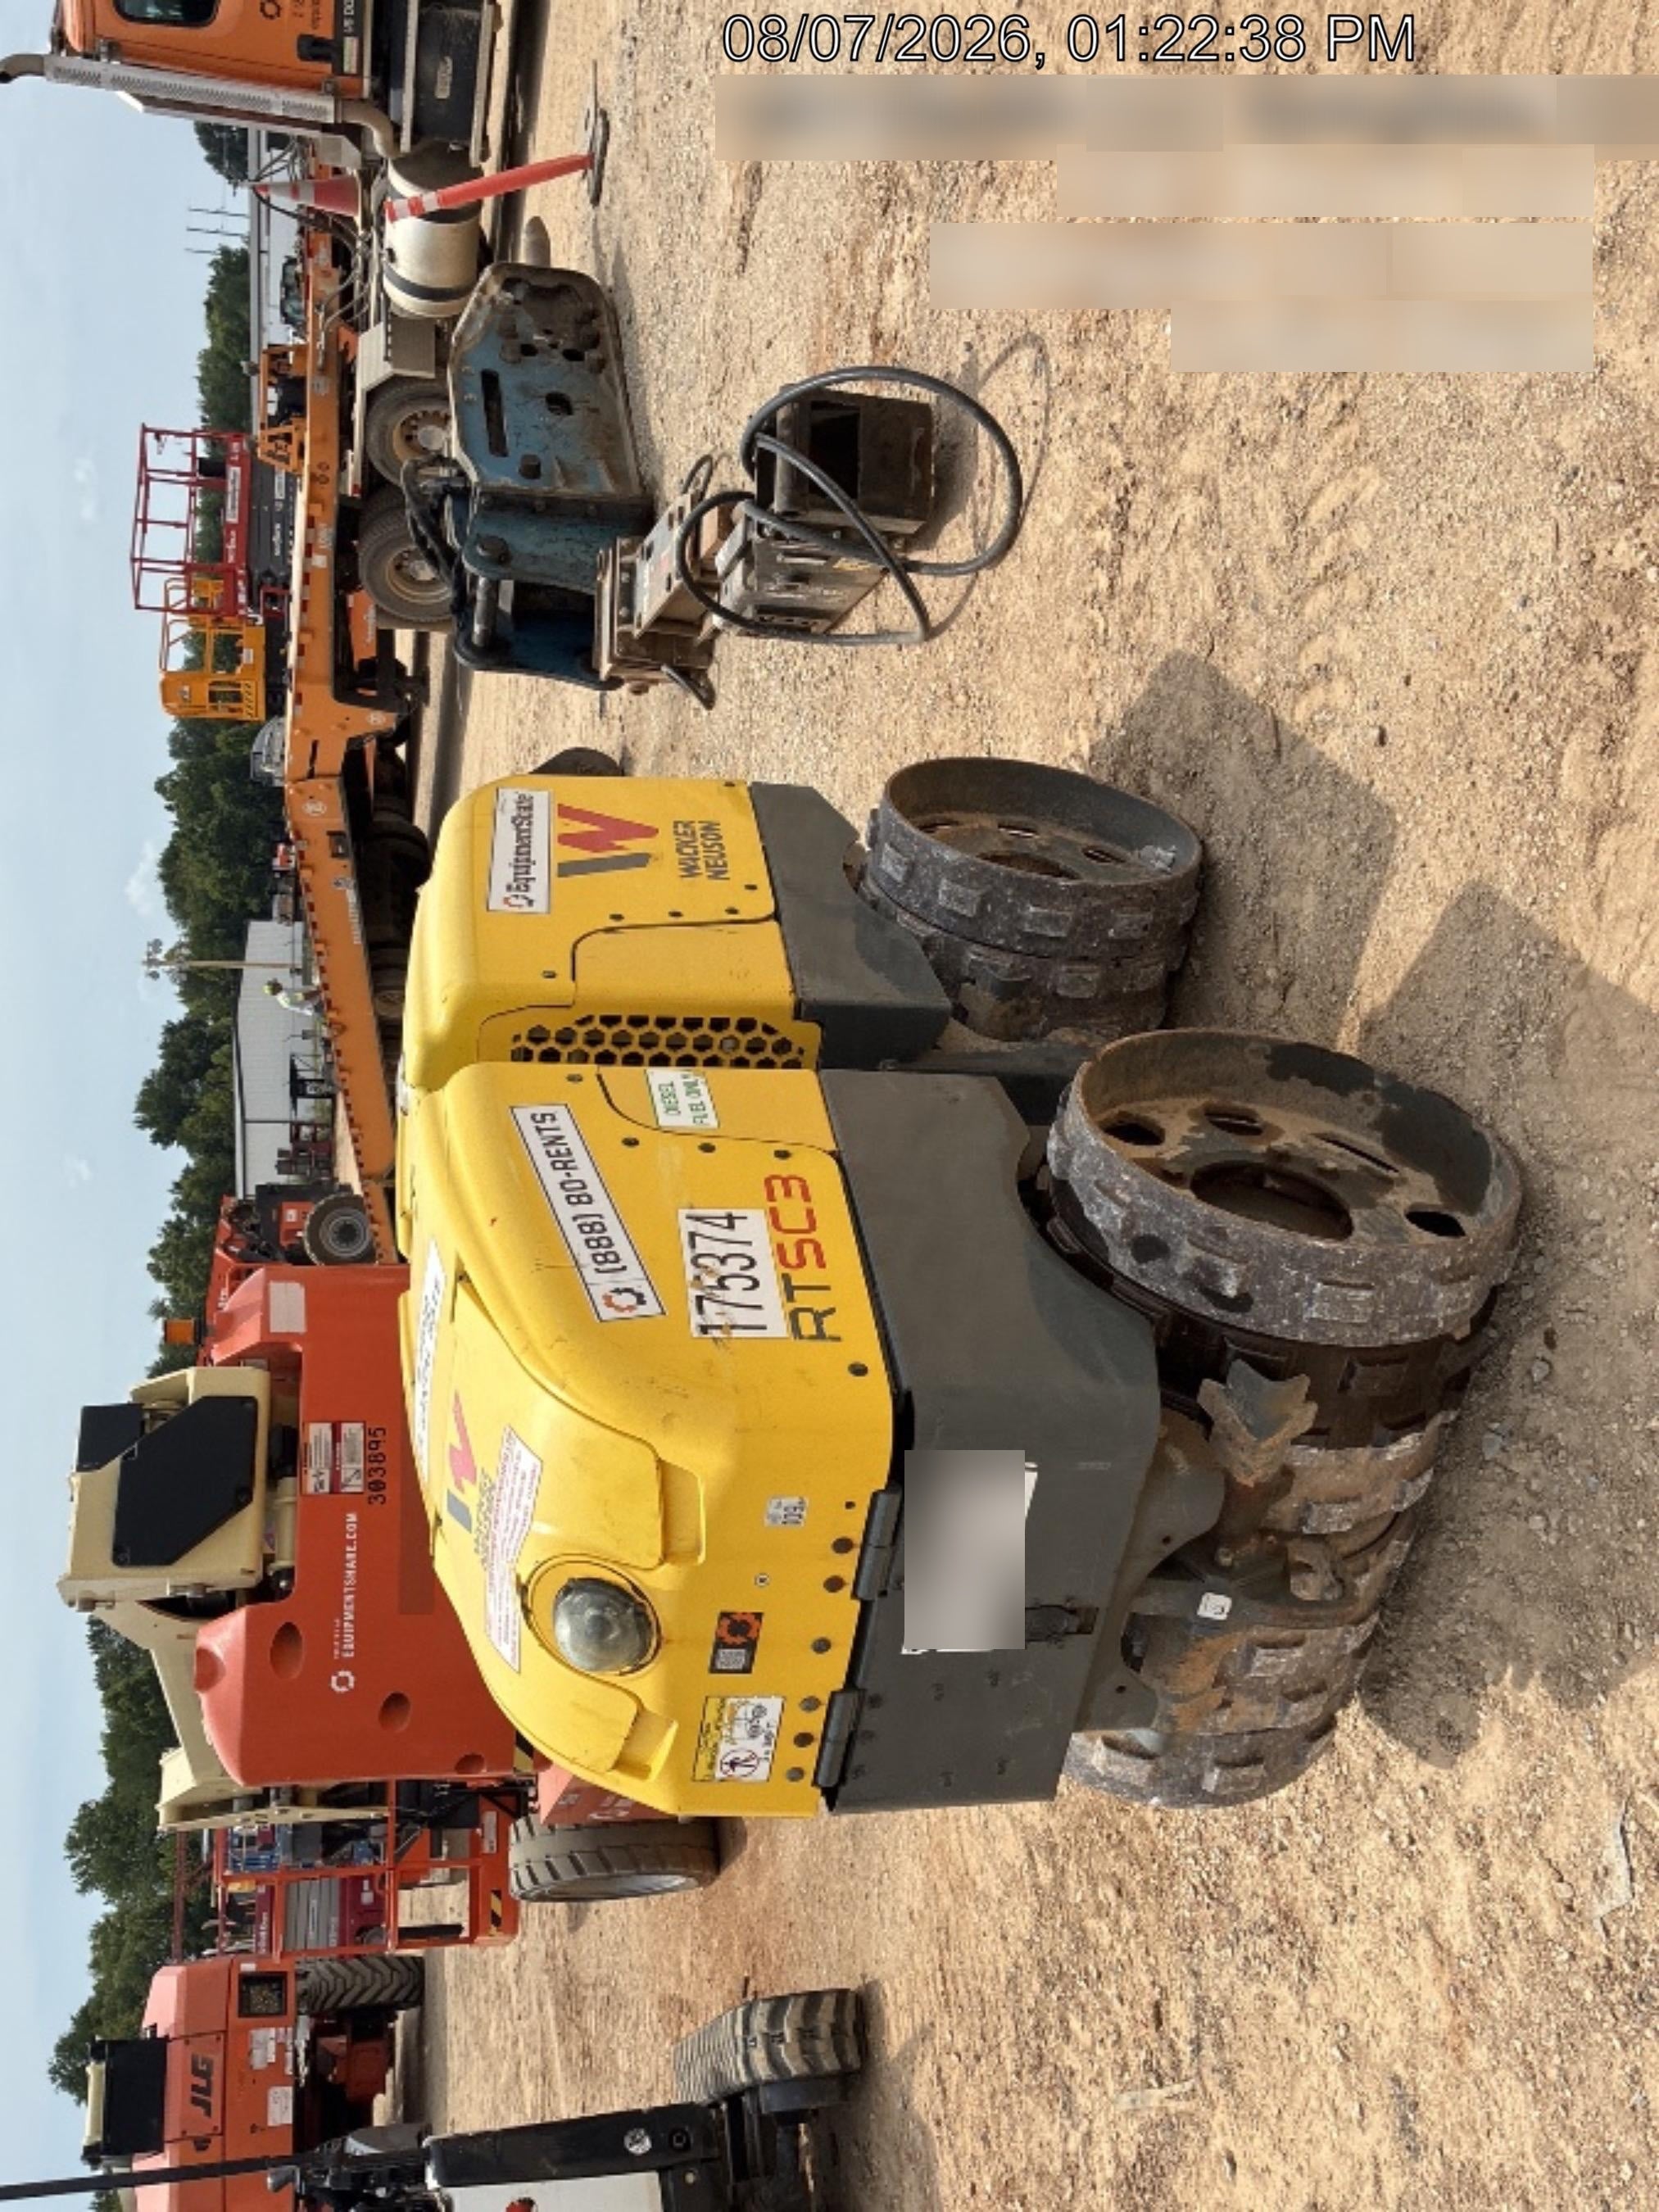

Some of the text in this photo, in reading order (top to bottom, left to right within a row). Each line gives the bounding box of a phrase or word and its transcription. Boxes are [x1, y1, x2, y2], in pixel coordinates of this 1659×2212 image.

[505, 791, 537, 893] EquipmentShare
[673, 820, 703, 878] WACKER
[698, 820, 730, 881] NEUSON
[658, 1081, 682, 1116] DIESEL
[688, 1100, 709, 1126] FUEL
[530, 1112, 628, 1274] (888) 80-RENTS
[685, 1212, 768, 1336] 175374
[764, 1174, 841, 1343] RTSC3
[367, 1426, 387, 1506] 303895
[341, 1512, 358, 1658] EQUIPMENTSHARE.COM
[191, 2052, 215, 2118] JLG
